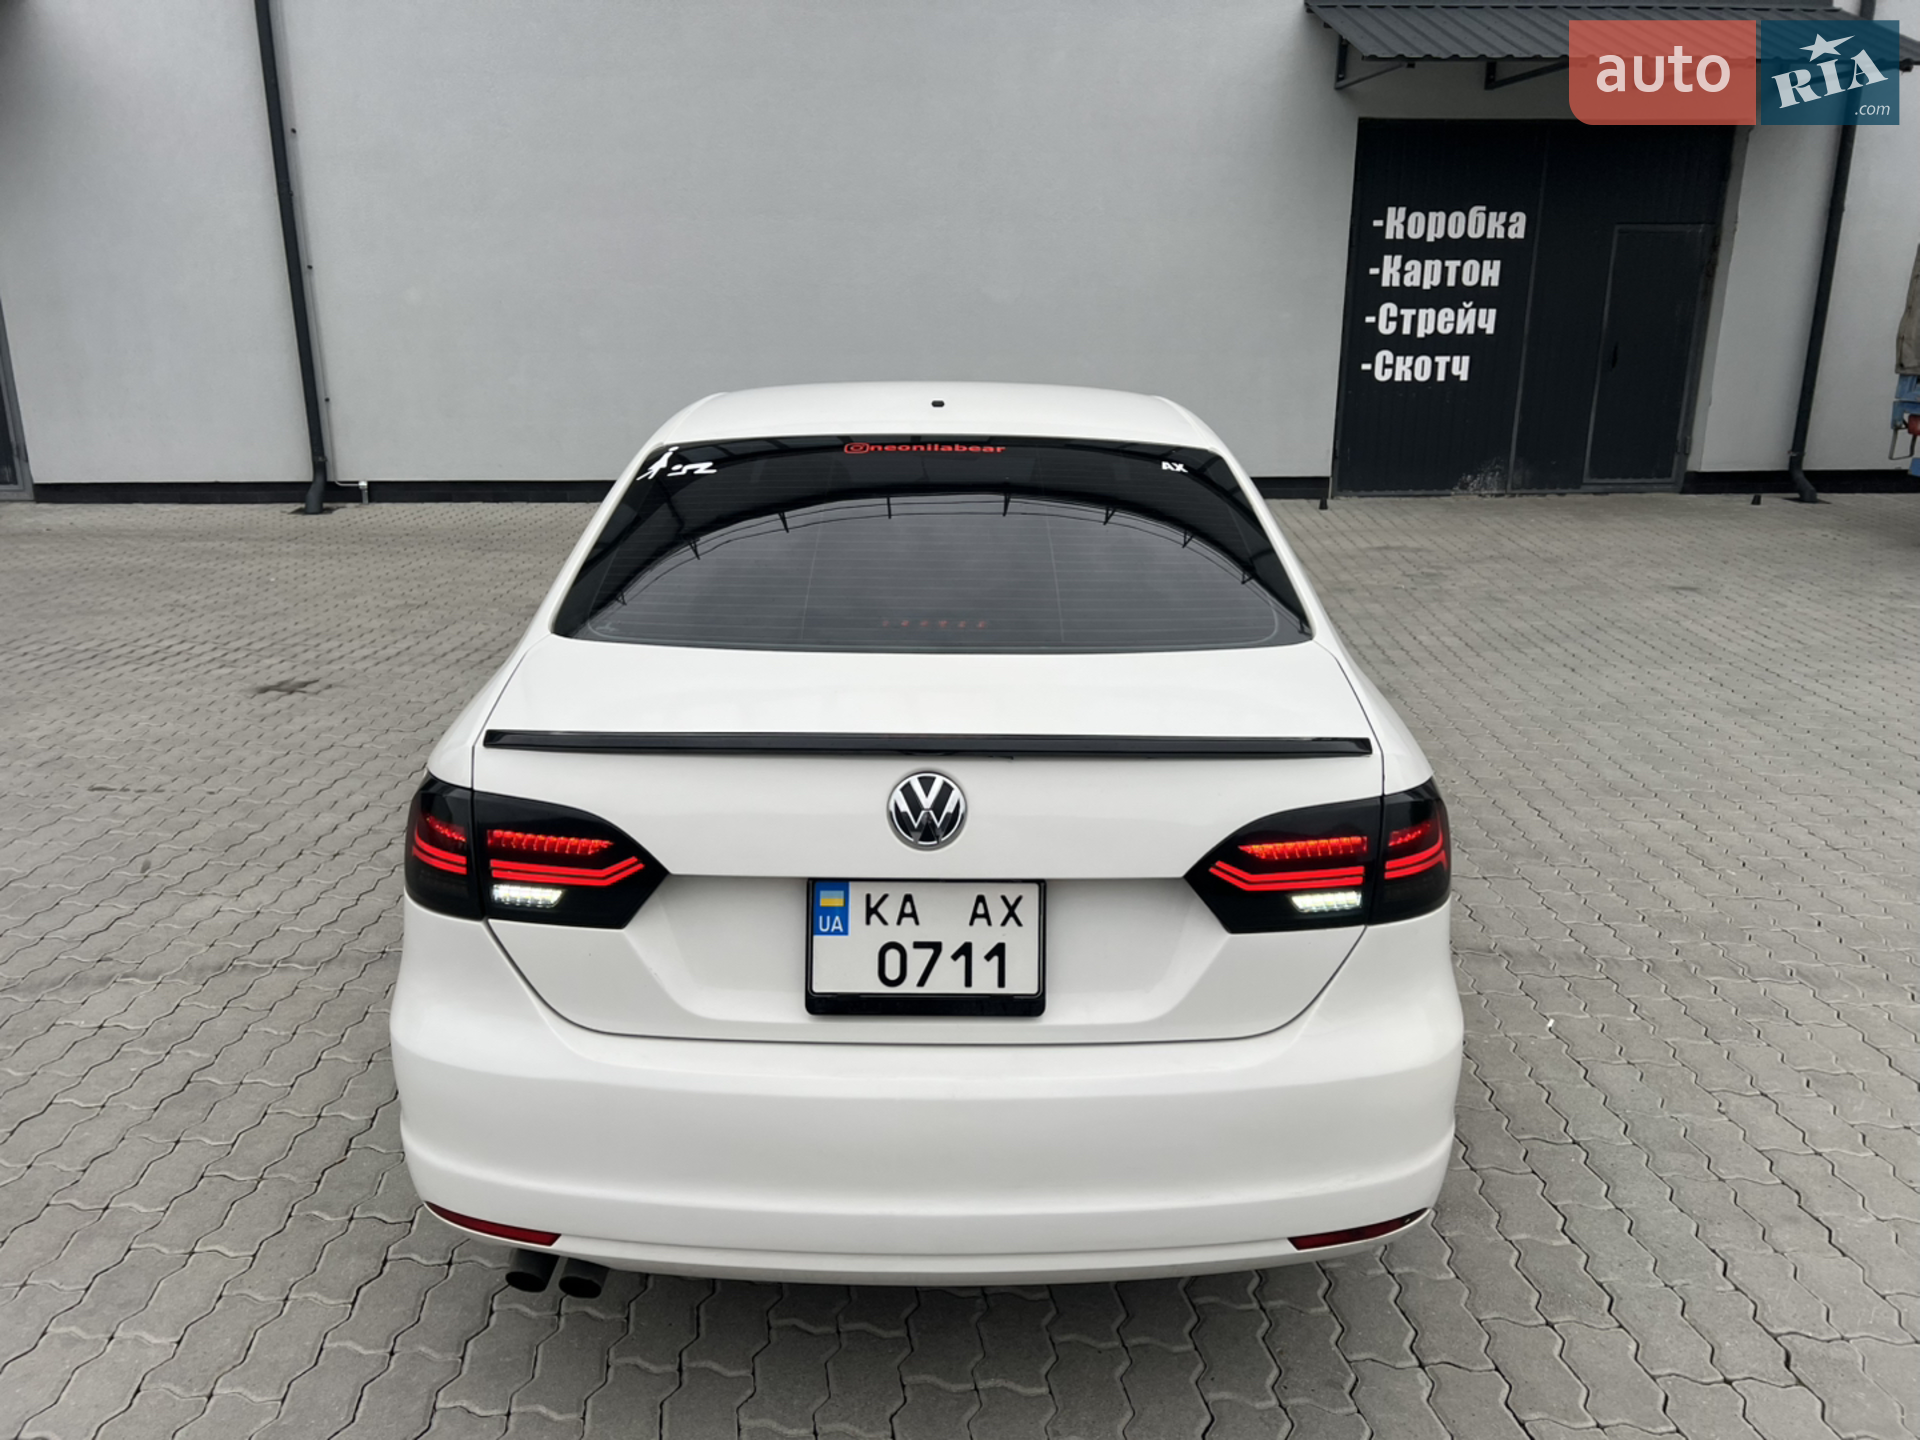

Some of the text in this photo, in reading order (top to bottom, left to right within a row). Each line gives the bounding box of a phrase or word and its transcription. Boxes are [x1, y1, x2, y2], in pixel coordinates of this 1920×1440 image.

[1372, 205, 1527, 242] -Коробка
[1369, 254, 1501, 290] -Картон
[1364, 301, 1497, 338] -Стрейч
[1360, 349, 1470, 382] -Скотч
[819, 915, 844, 933] UA
[865, 893, 1023, 927] KA AX
[877, 940, 1006, 989] 0711
